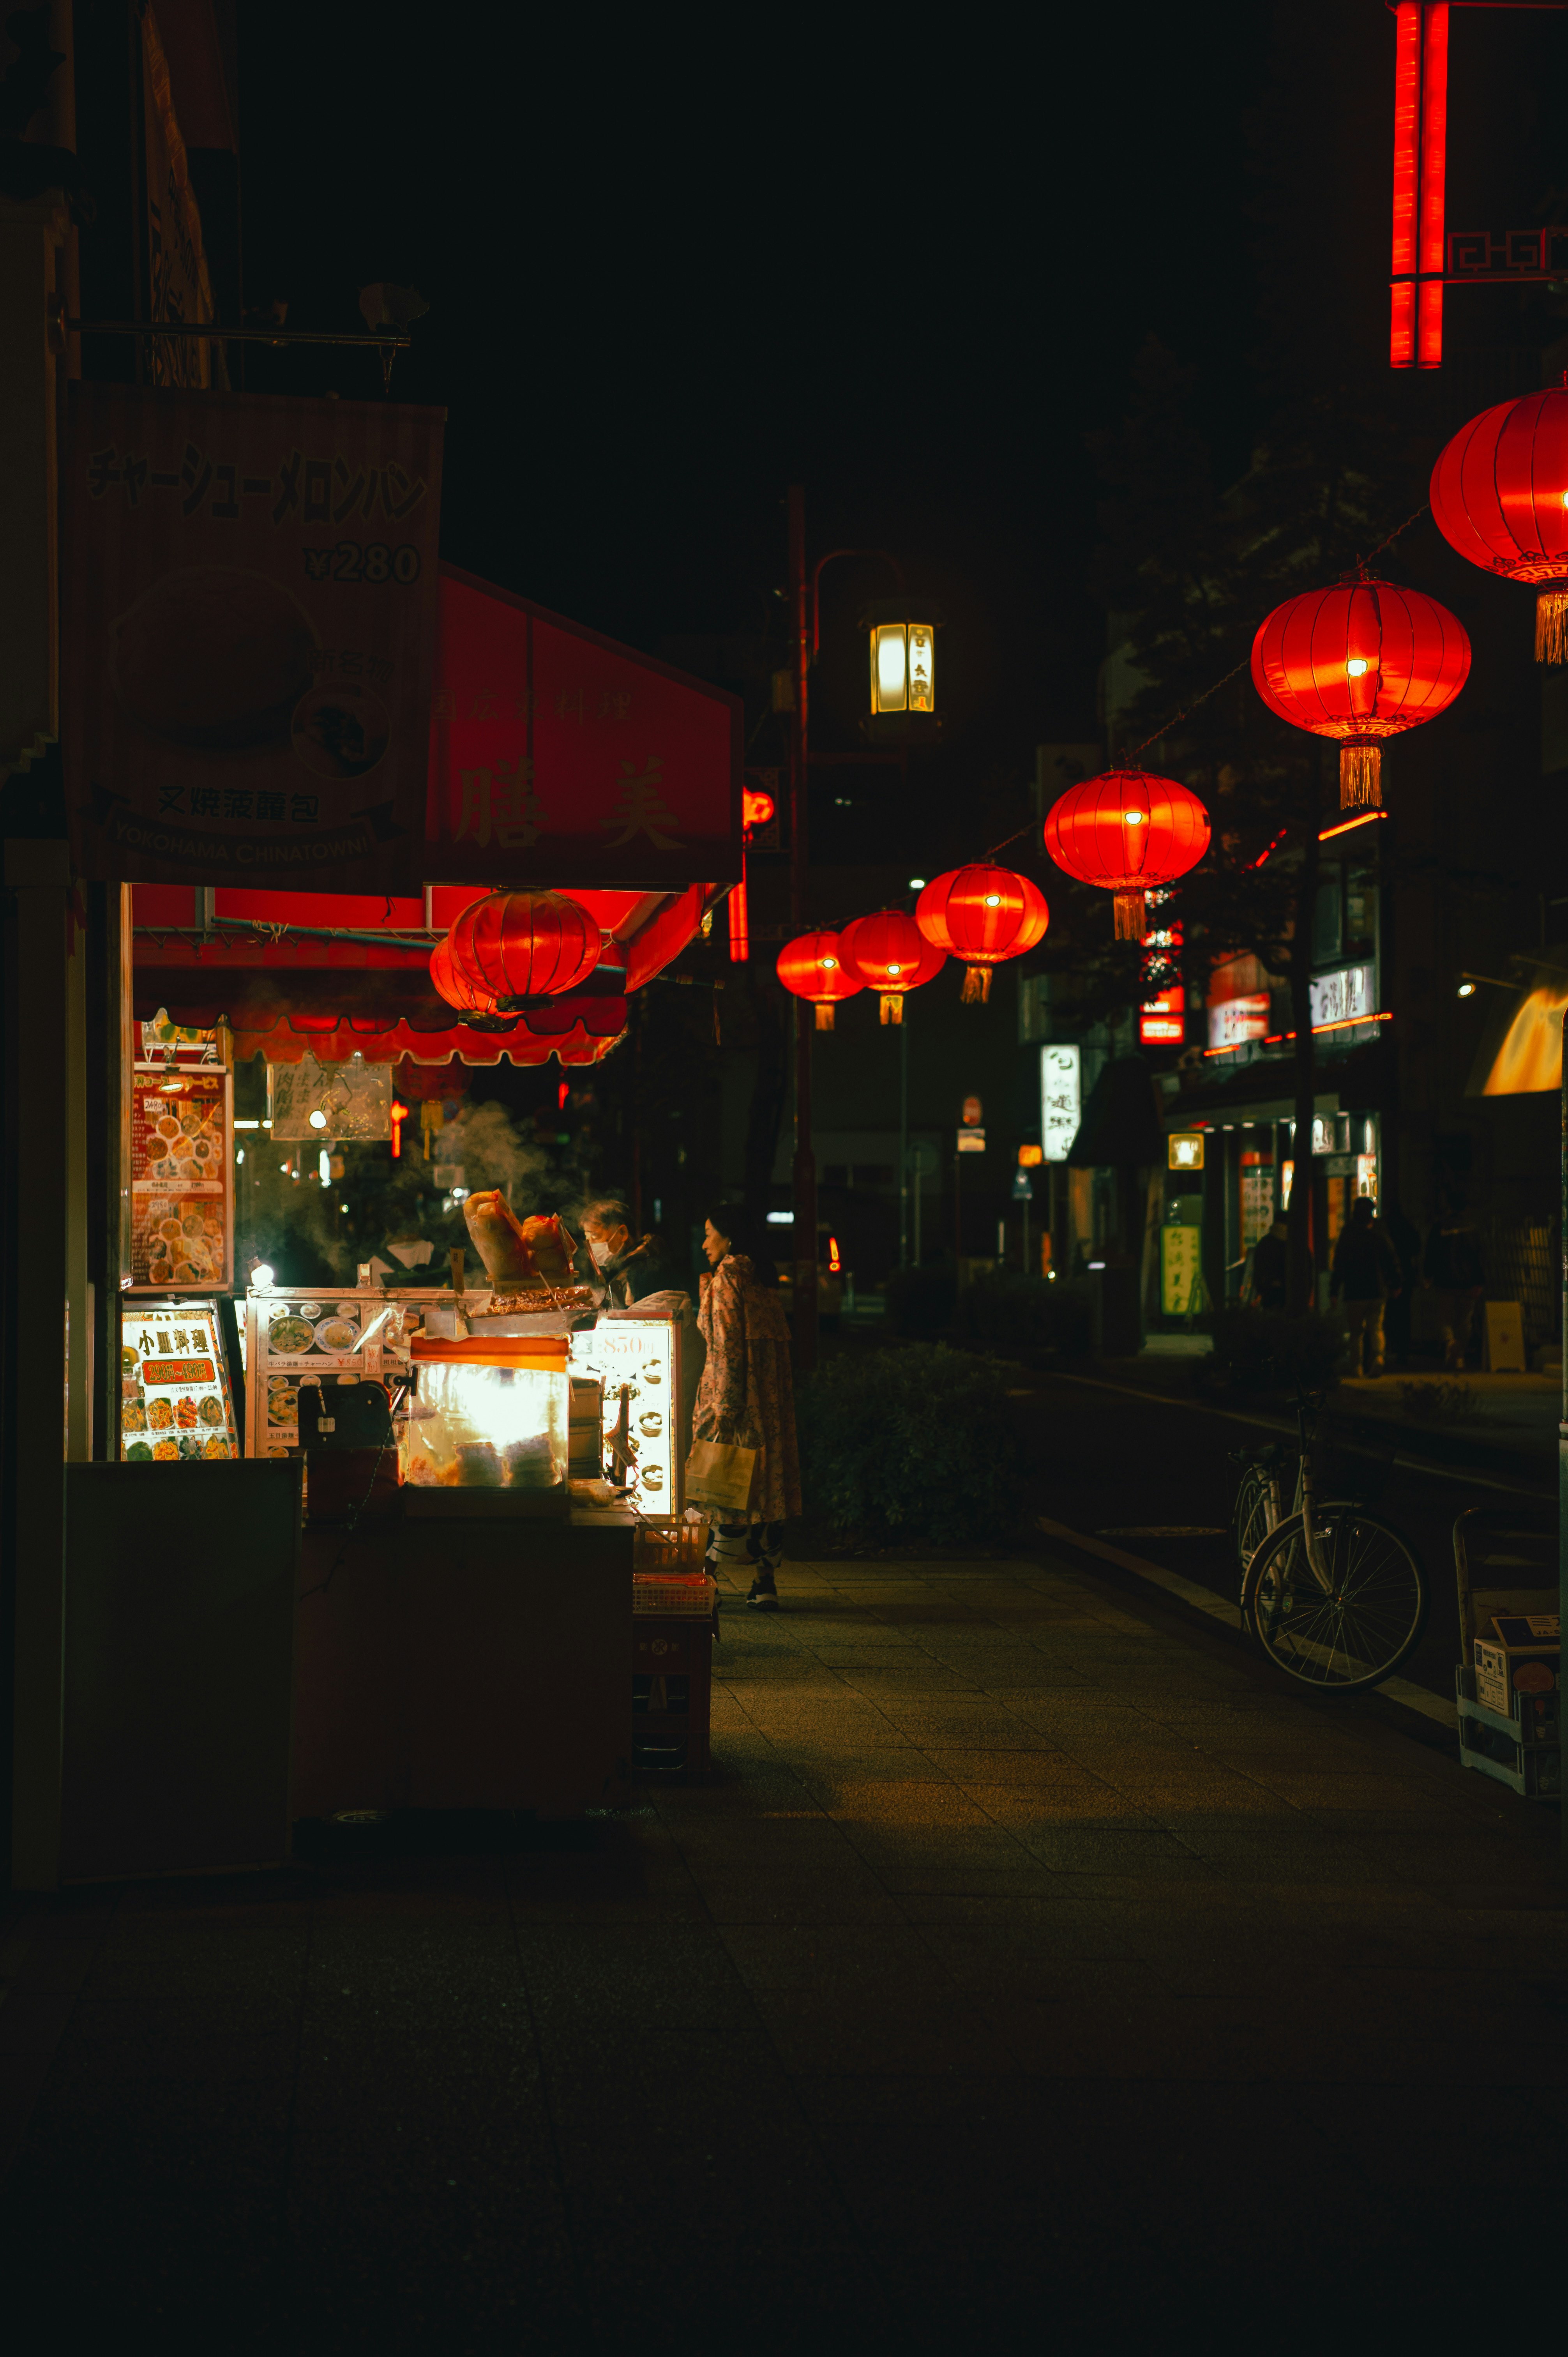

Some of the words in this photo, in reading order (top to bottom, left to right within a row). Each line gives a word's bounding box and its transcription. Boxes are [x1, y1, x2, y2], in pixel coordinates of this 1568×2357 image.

[89, 439, 428, 527] チャーシューメロンパン
[302, 541, 421, 586] ¥280
[306, 648, 395, 685] 新名物
[114, 820, 228, 860] YOKOHAMA
[139, 1329, 209, 1356] 小皿料理
[337, 1358, 362, 1366] ¥850
